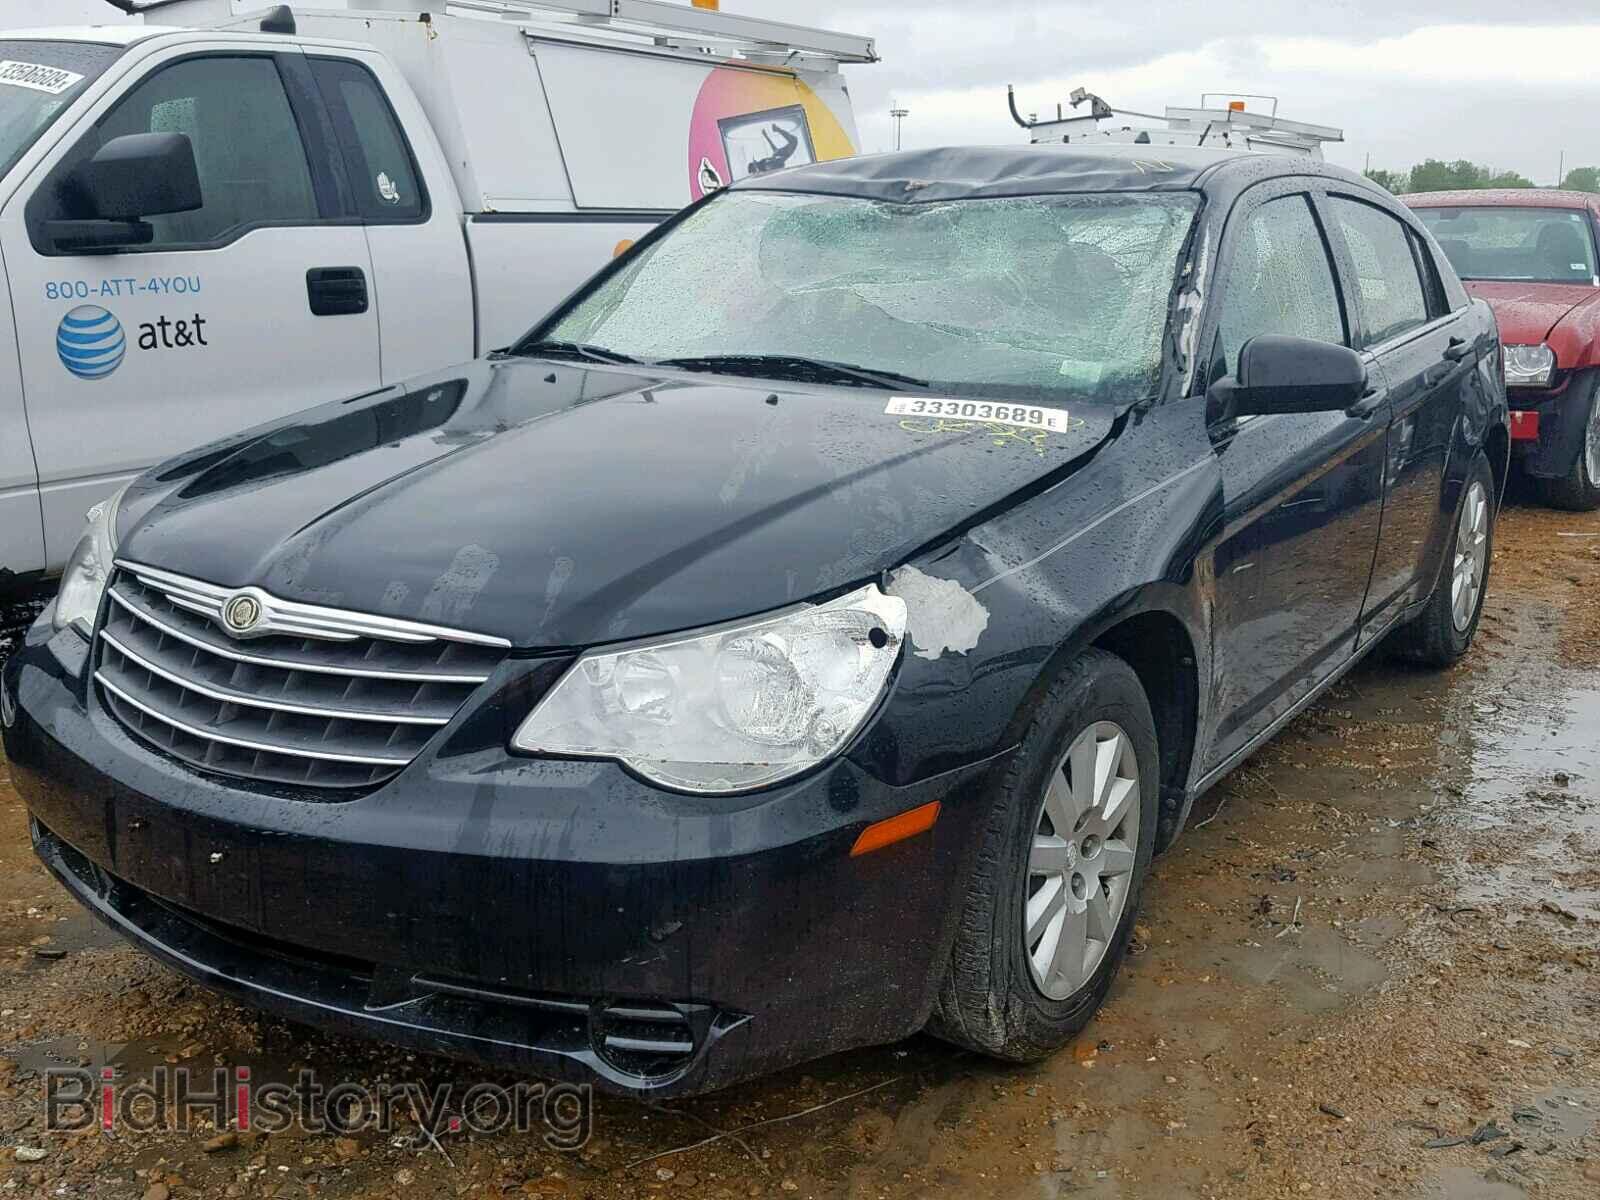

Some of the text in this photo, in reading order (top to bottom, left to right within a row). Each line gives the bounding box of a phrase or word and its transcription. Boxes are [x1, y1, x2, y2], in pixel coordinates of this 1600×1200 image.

[45, 276, 201, 300] 800-ATT-4YOU
[137, 313, 208, 351] at&t
[910, 400, 1043, 425] 33303689
